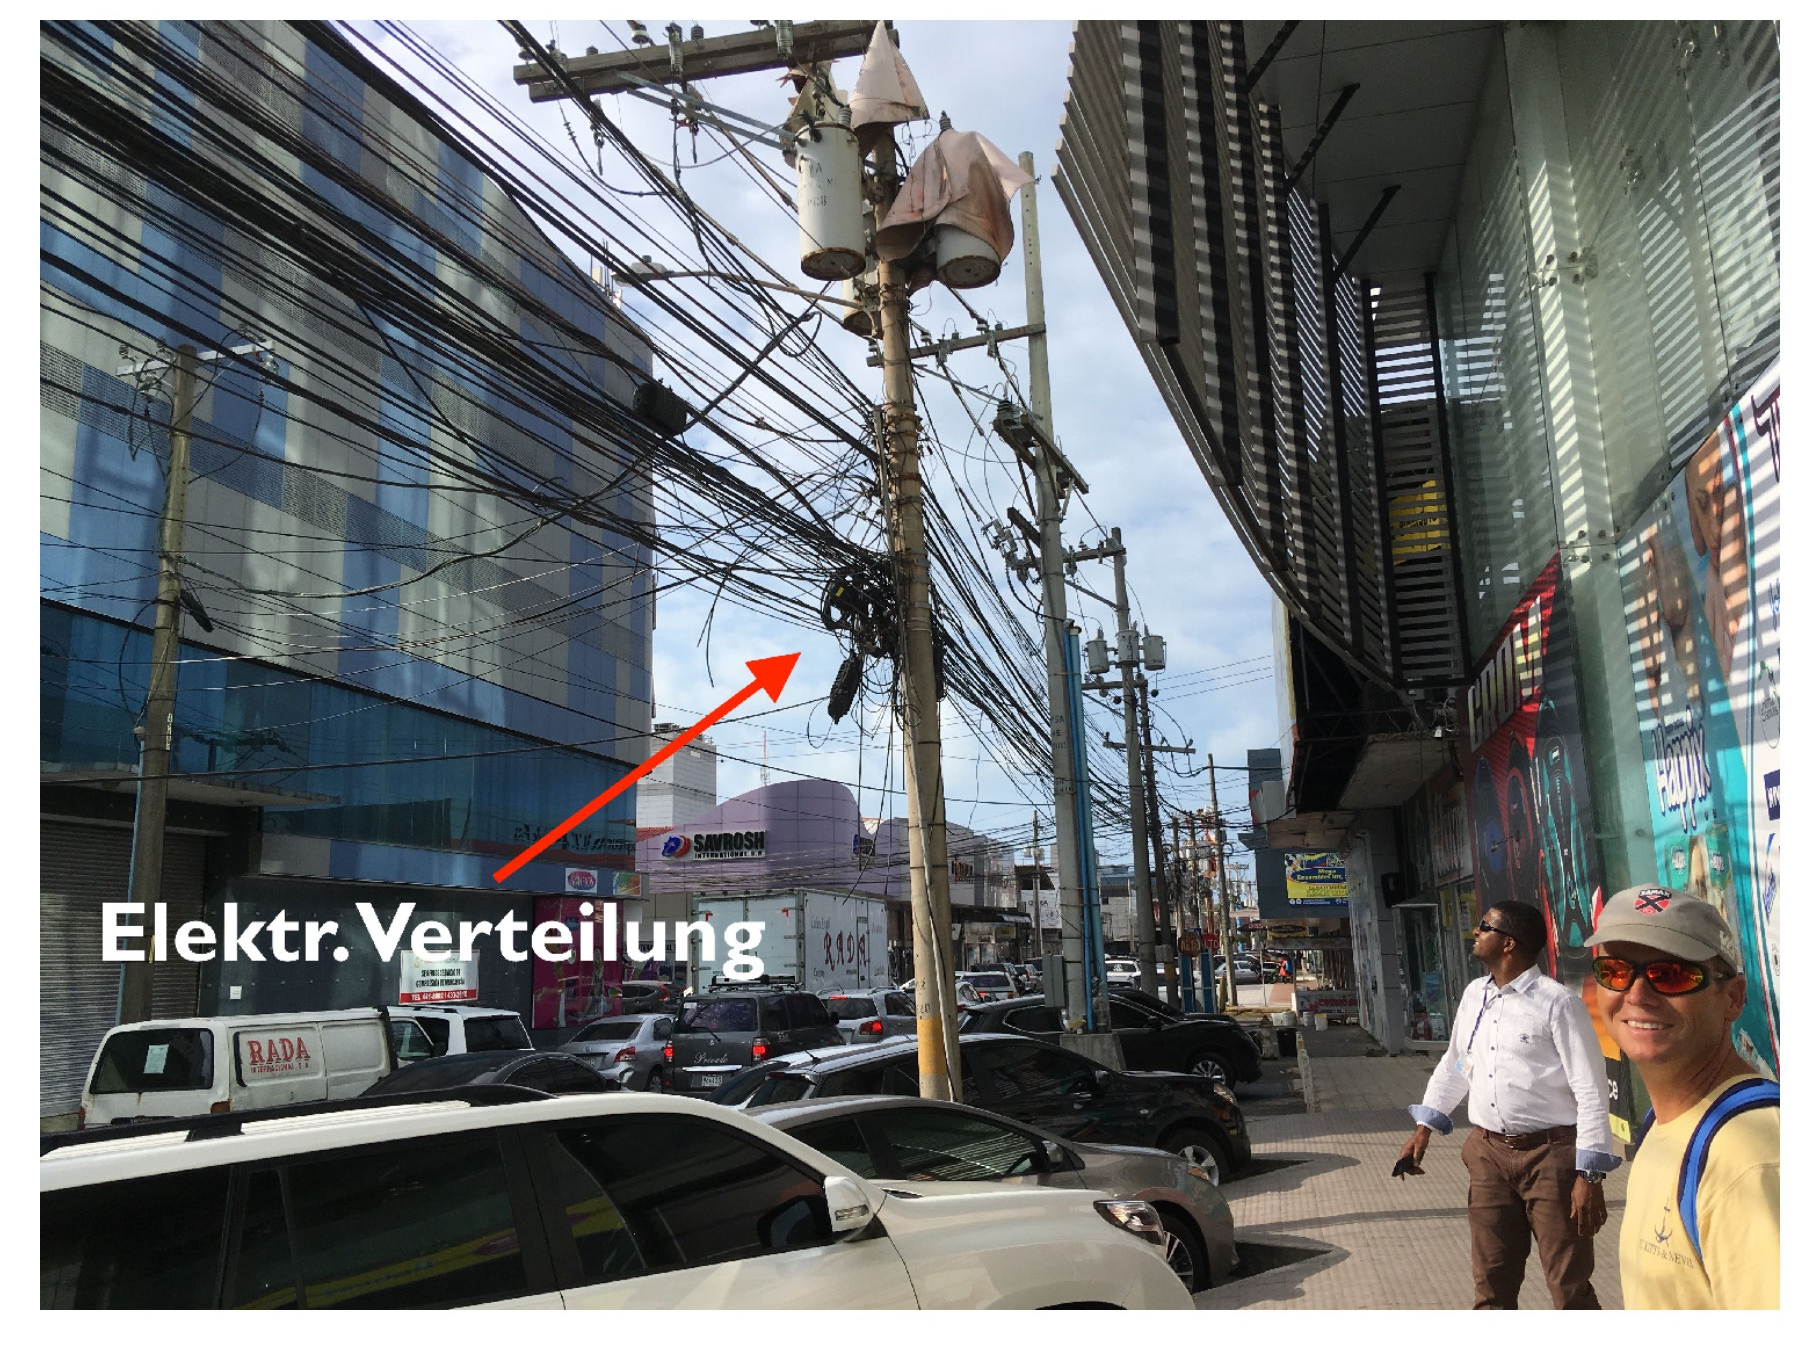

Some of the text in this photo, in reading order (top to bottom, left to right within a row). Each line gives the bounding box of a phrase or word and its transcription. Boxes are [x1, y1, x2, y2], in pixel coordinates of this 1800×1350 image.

[693, 831, 765, 852] SAVROSH
[247, 1036, 311, 1065] RADA
[1668, 1251, 1694, 1270] NEVIS
